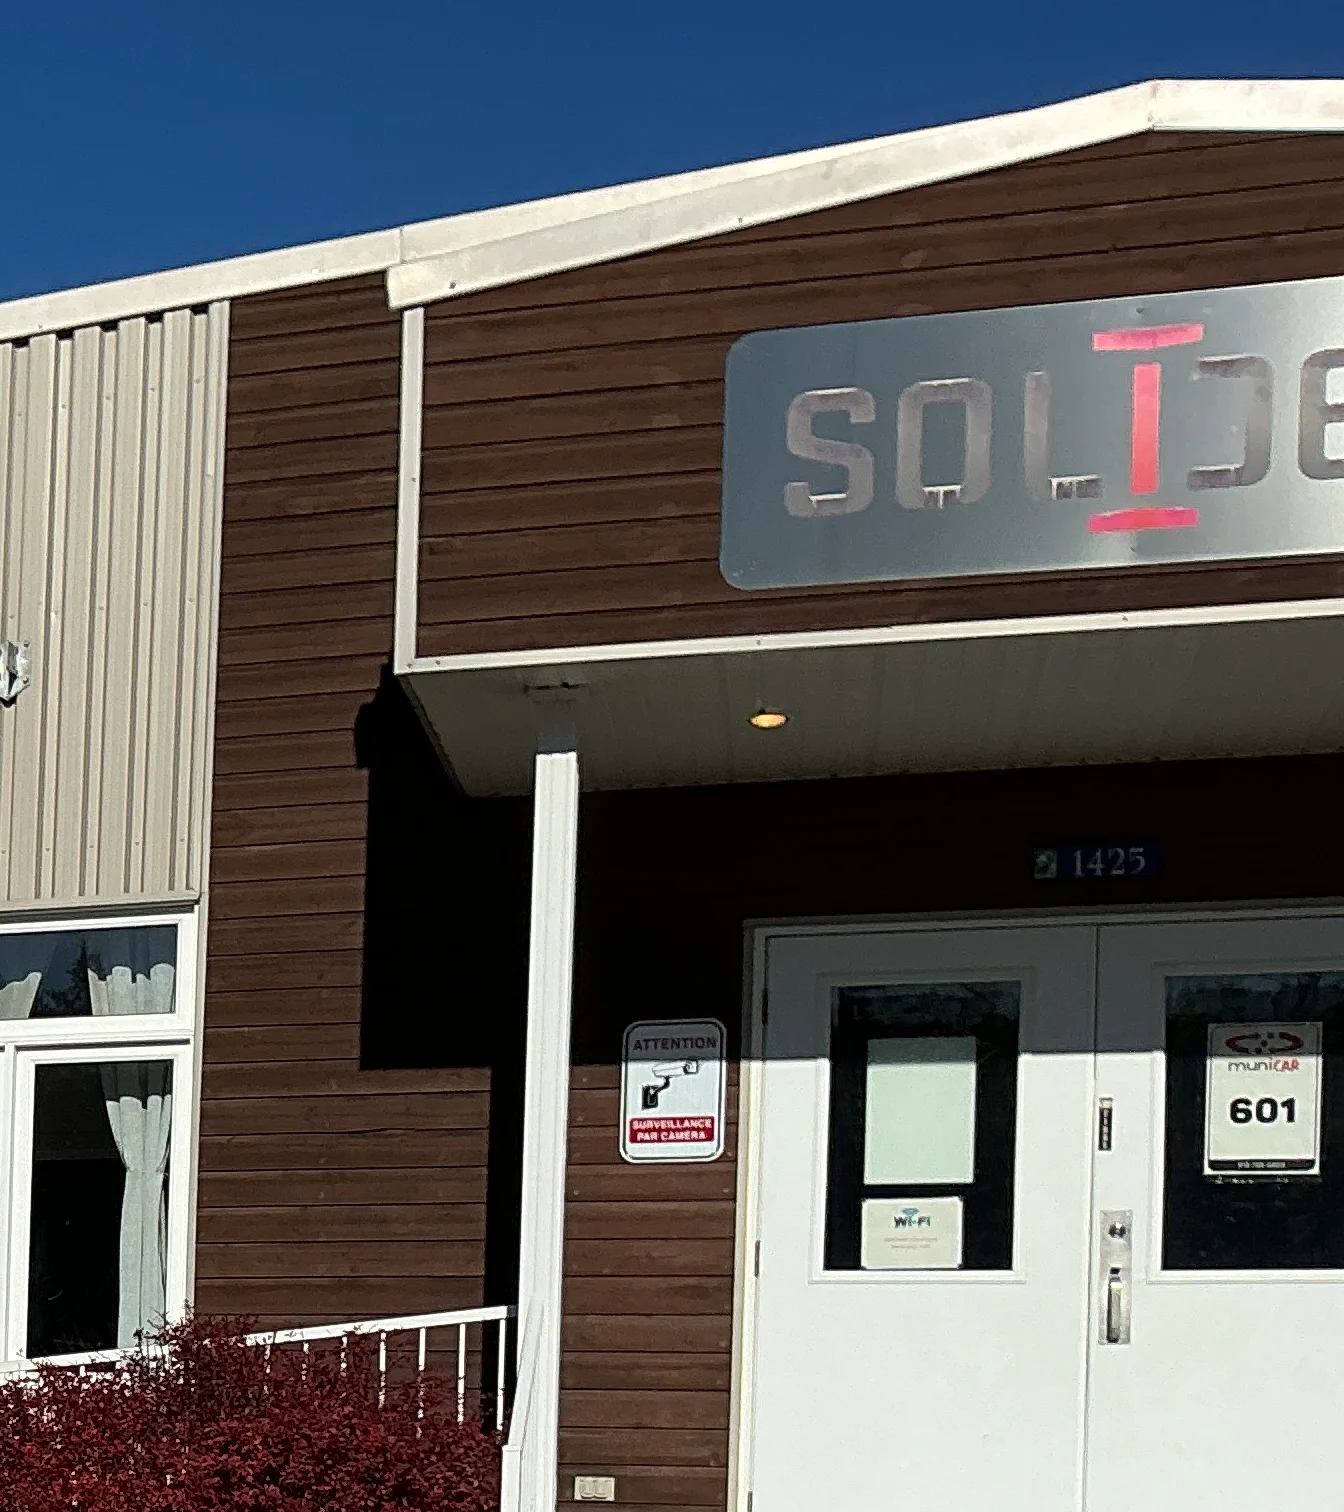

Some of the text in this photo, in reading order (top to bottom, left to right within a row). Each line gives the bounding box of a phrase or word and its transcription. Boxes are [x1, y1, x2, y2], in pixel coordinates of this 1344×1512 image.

[1073, 847, 1146, 877] 1425
[632, 1036, 717, 1051] ATTENTION
[1229, 1098, 1296, 1124] 601
[632, 1119, 712, 1130] SURVEILLANCE
[636, 1131, 658, 1142] PAR
